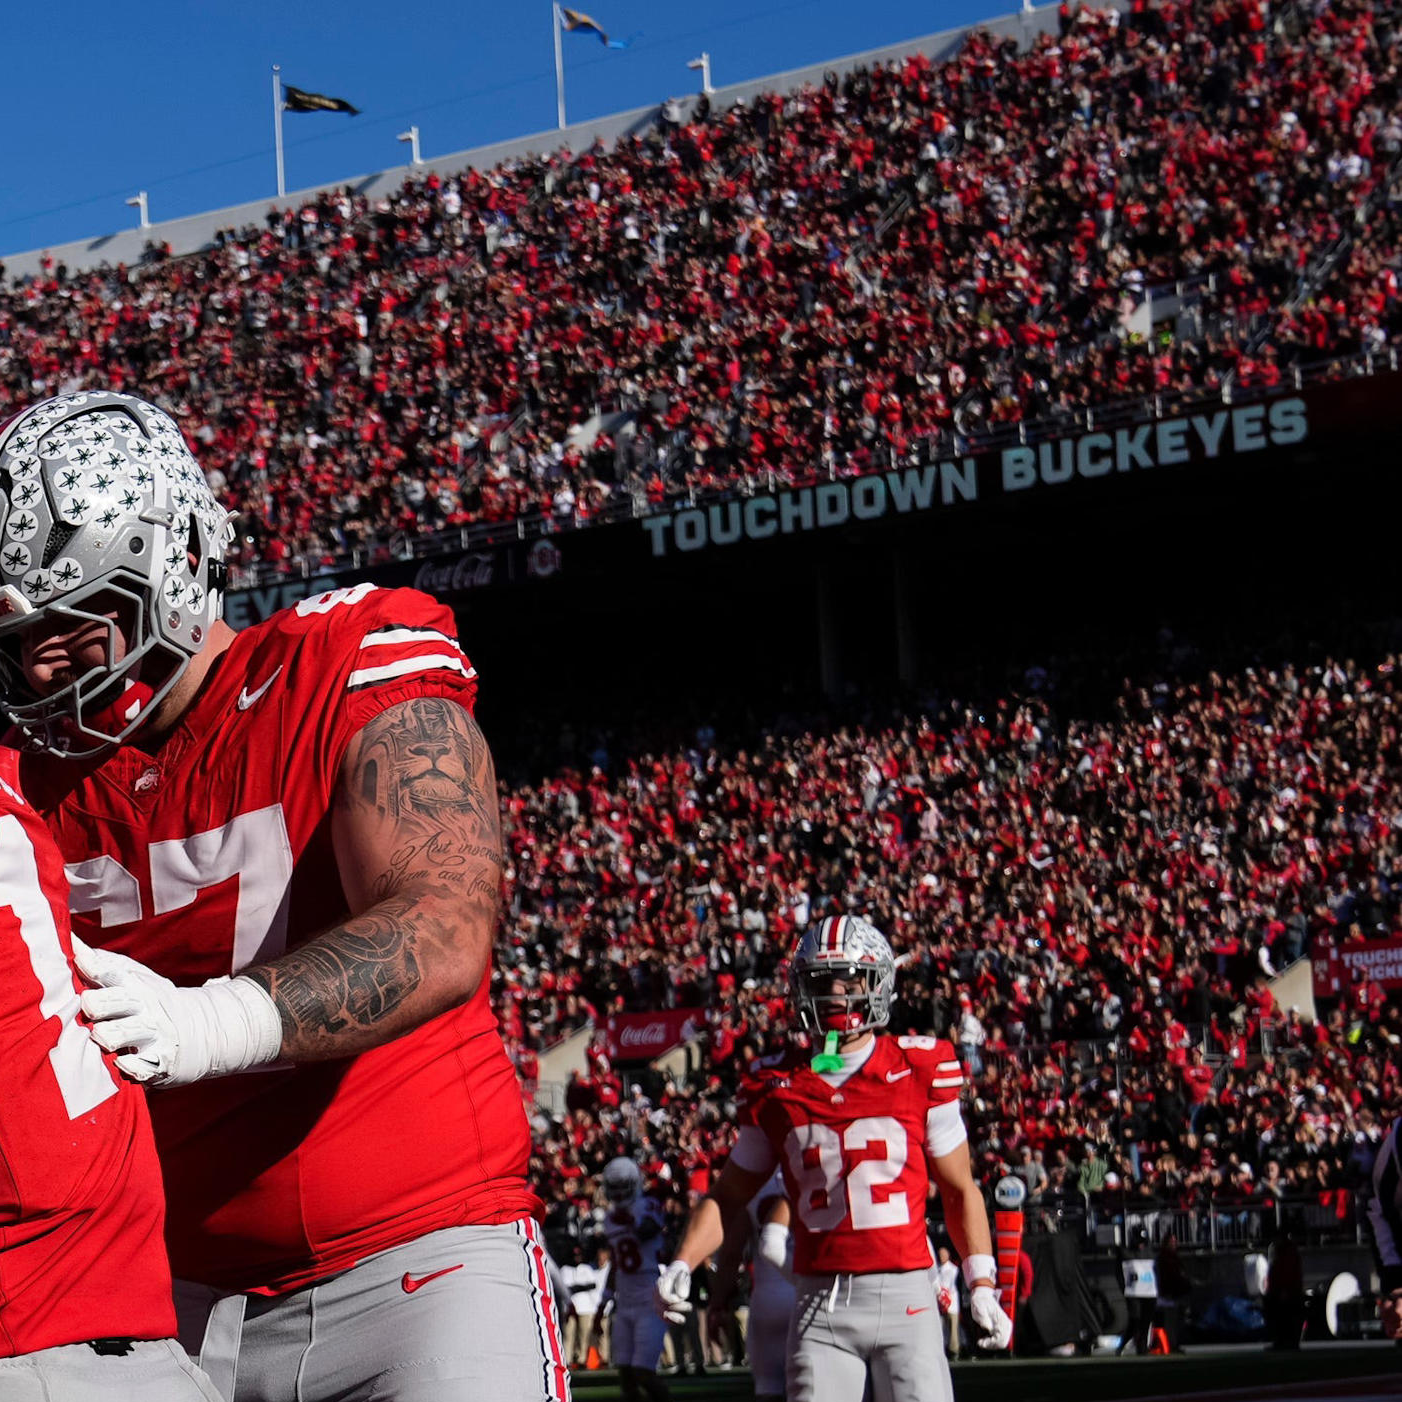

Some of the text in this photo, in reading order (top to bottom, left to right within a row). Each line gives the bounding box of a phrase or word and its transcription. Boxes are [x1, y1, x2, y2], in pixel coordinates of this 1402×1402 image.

[642, 397, 1308, 557] TOUCHDOWN BUCKEYES
[783, 1115, 911, 1234] 82
